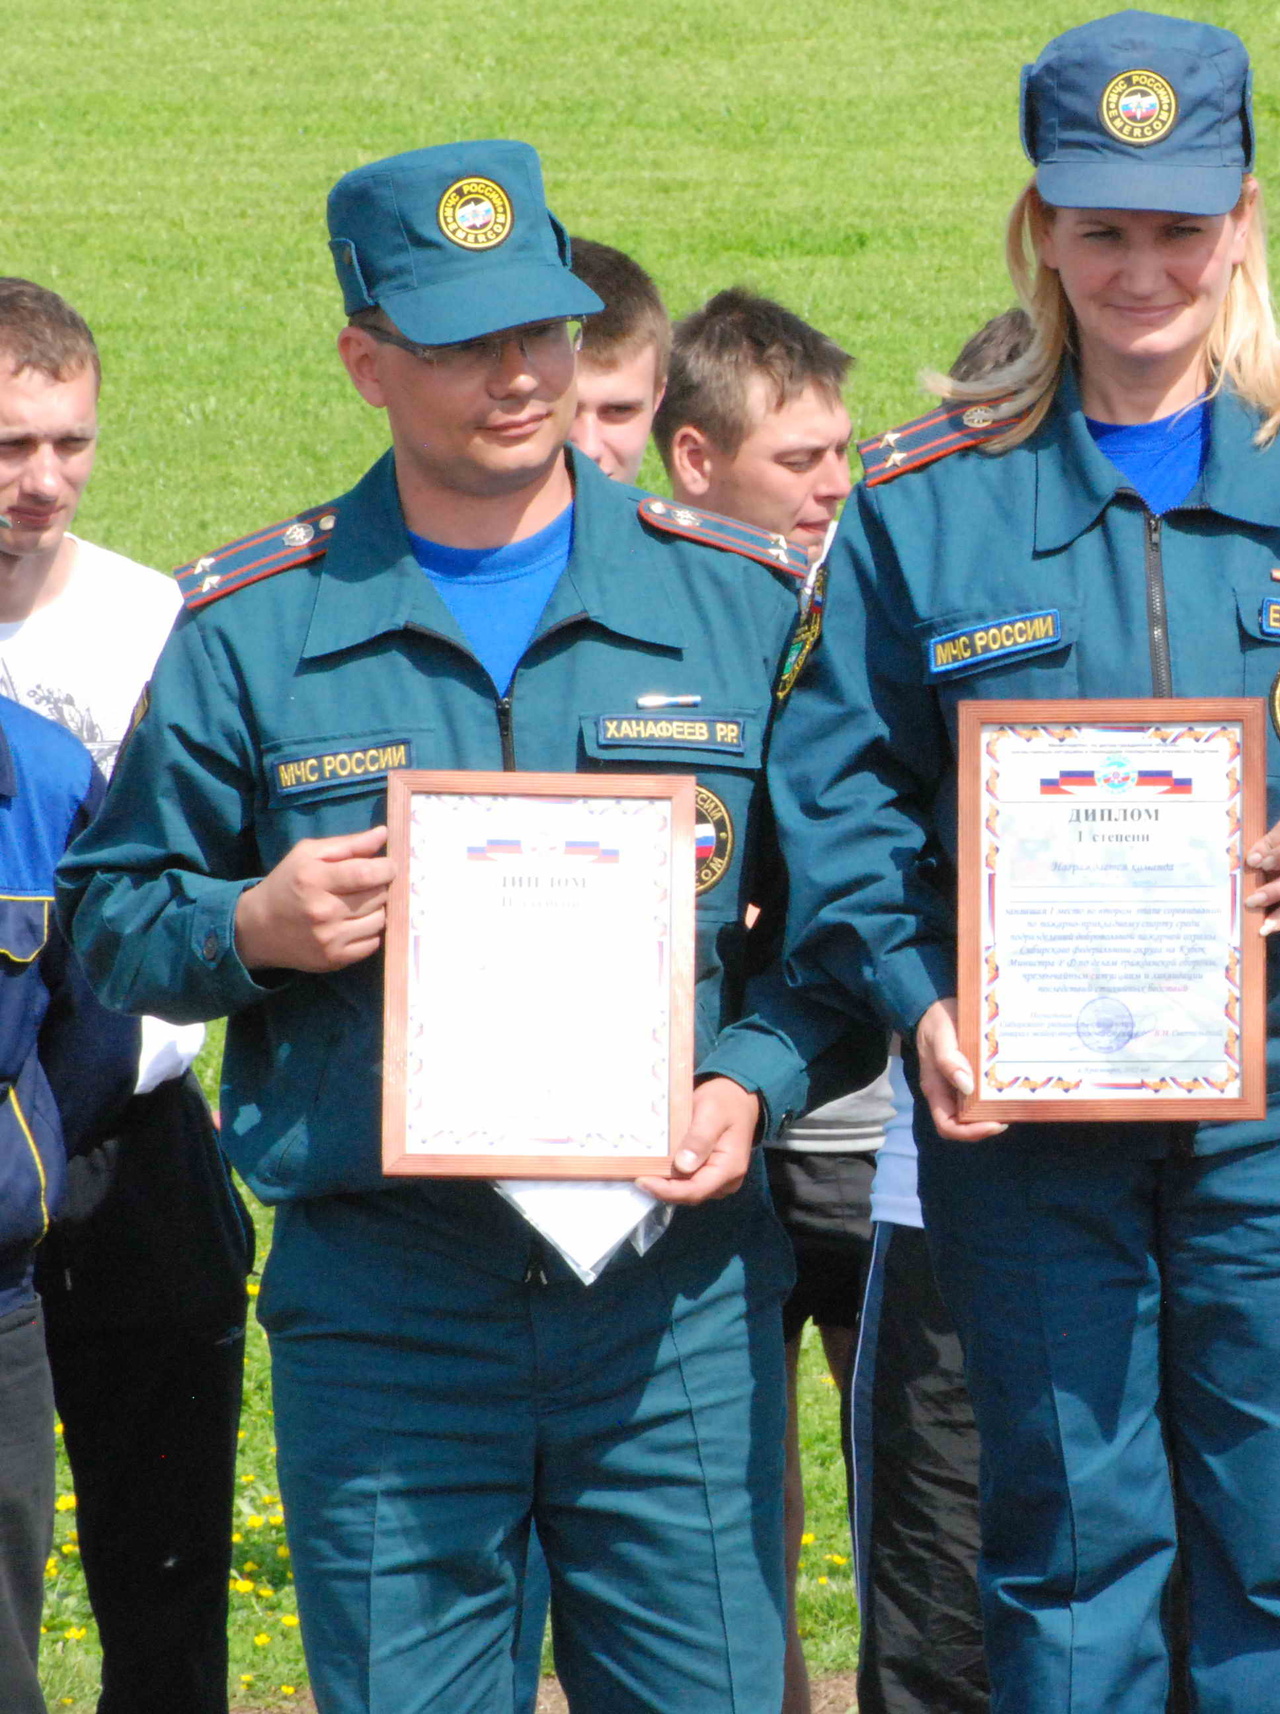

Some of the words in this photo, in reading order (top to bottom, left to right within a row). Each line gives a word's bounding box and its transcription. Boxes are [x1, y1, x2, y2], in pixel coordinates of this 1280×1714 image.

[1108, 80, 1127, 103] МЧС
[1131, 75, 1170, 104] РОССИИ
[1108, 109, 1170, 137] EMERCOM
[444, 192, 460, 217] МЧС
[462, 183, 504, 207] РОССИИ
[447, 213, 506, 243] EMERCOM
[936, 636, 971, 666] МЧС
[974, 616, 1053, 654] РОССИИ
[605, 719, 709, 741] ХАНАФЕЕВ
[716, 721, 739, 744] Р.Р.
[279, 758, 318, 787] МЧС
[323, 744, 406, 778] РОССИИ
[1068, 808, 1160, 823] ДИПЛОМ
[1092, 832, 1150, 843] степени
